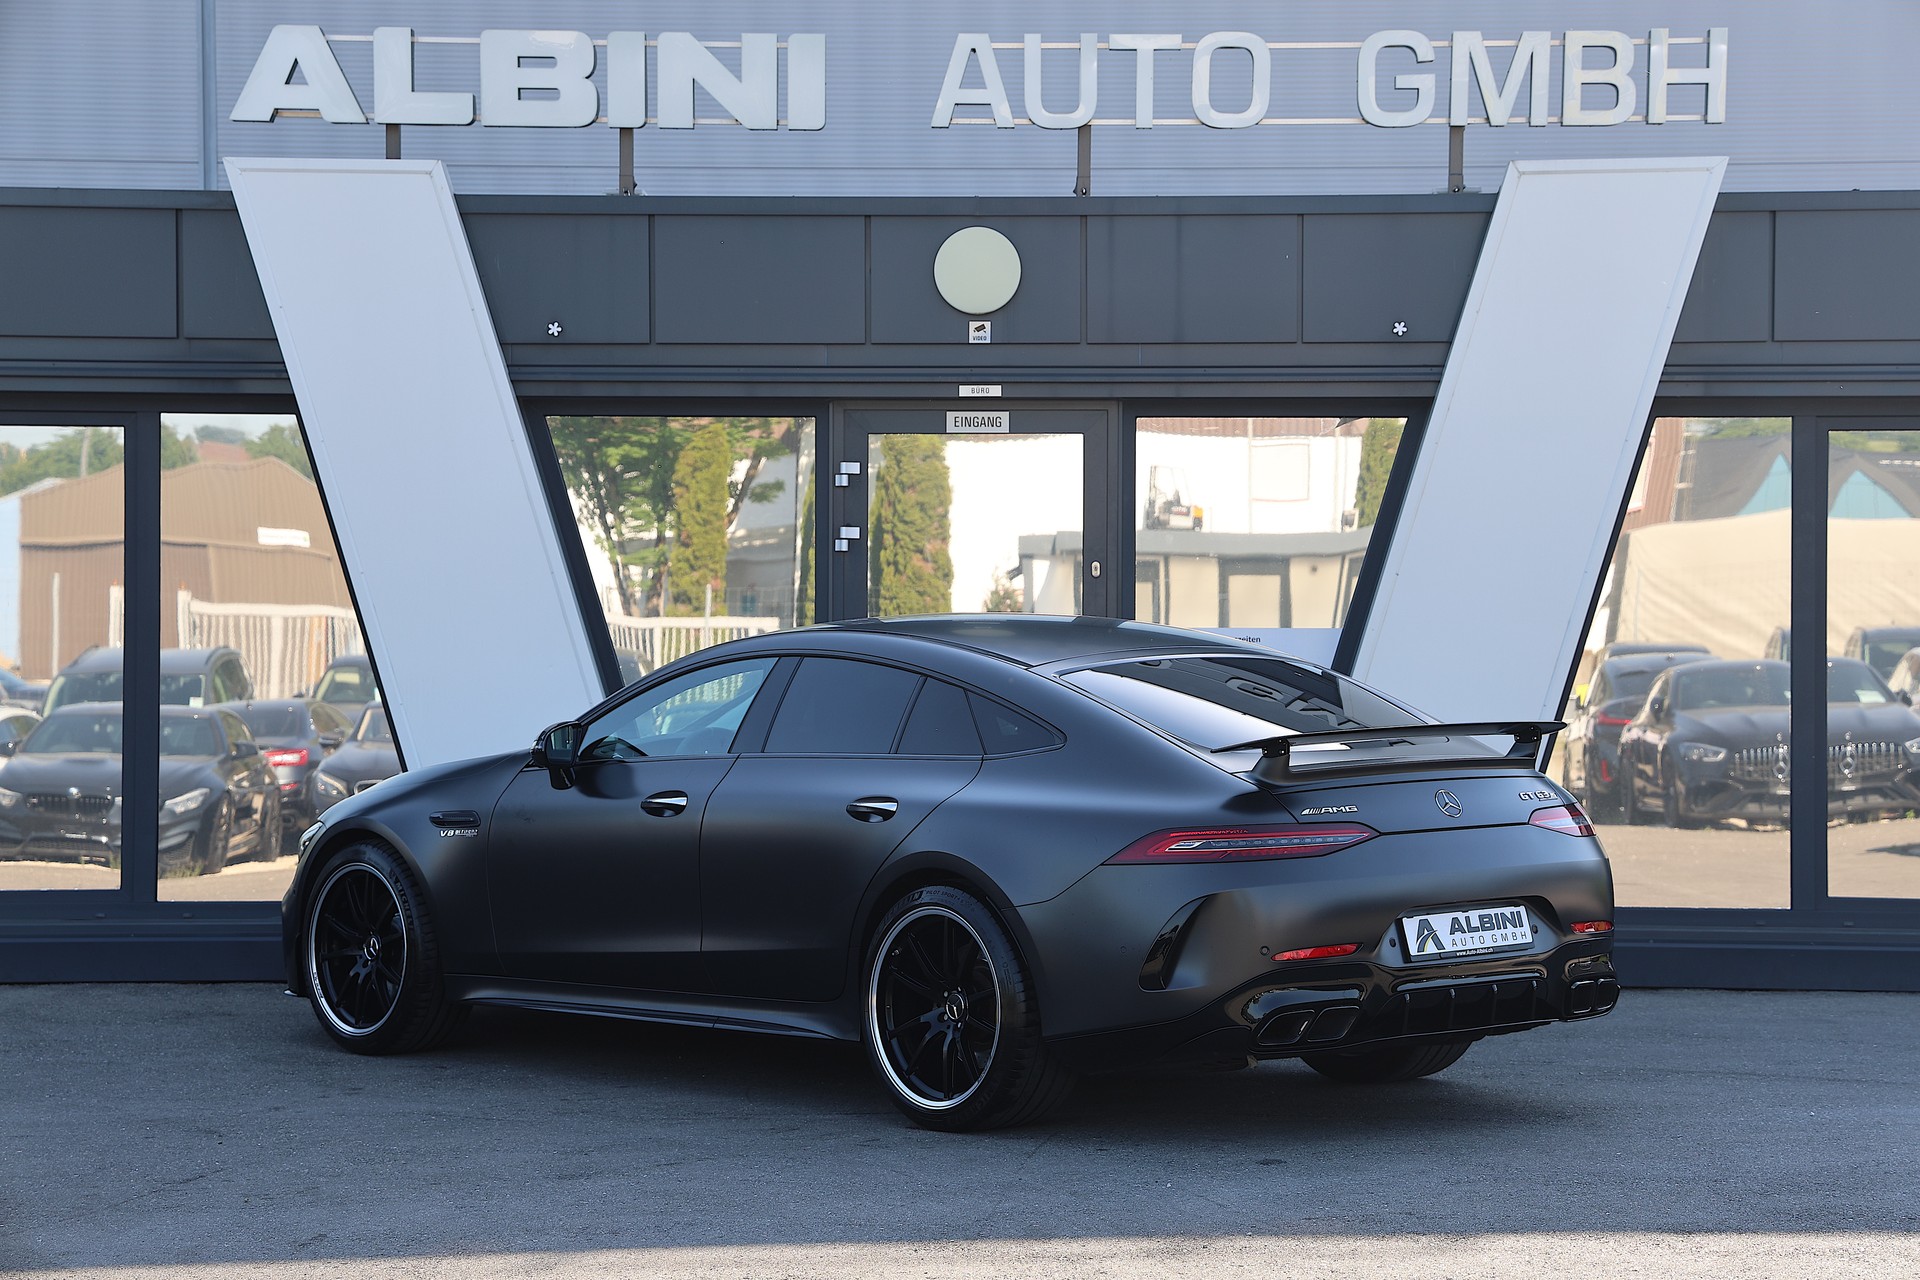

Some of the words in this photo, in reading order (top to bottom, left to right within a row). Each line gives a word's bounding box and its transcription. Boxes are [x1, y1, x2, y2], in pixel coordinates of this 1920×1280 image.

[229, 24, 826, 131] ALBINI
[930, 31, 1271, 130] AUTO
[1356, 27, 1728, 129] GMBH
[971, 386, 990, 394] BÜRO
[954, 416, 1002, 428] EINGANG
[1518, 791, 1534, 801] GT
[1320, 804, 1359, 814] AMG
[440, 829, 454, 837] V8
[1449, 911, 1524, 935] ALBINI
[1451, 936, 1486, 947] AUTO
[1491, 931, 1528, 944] GMBH
